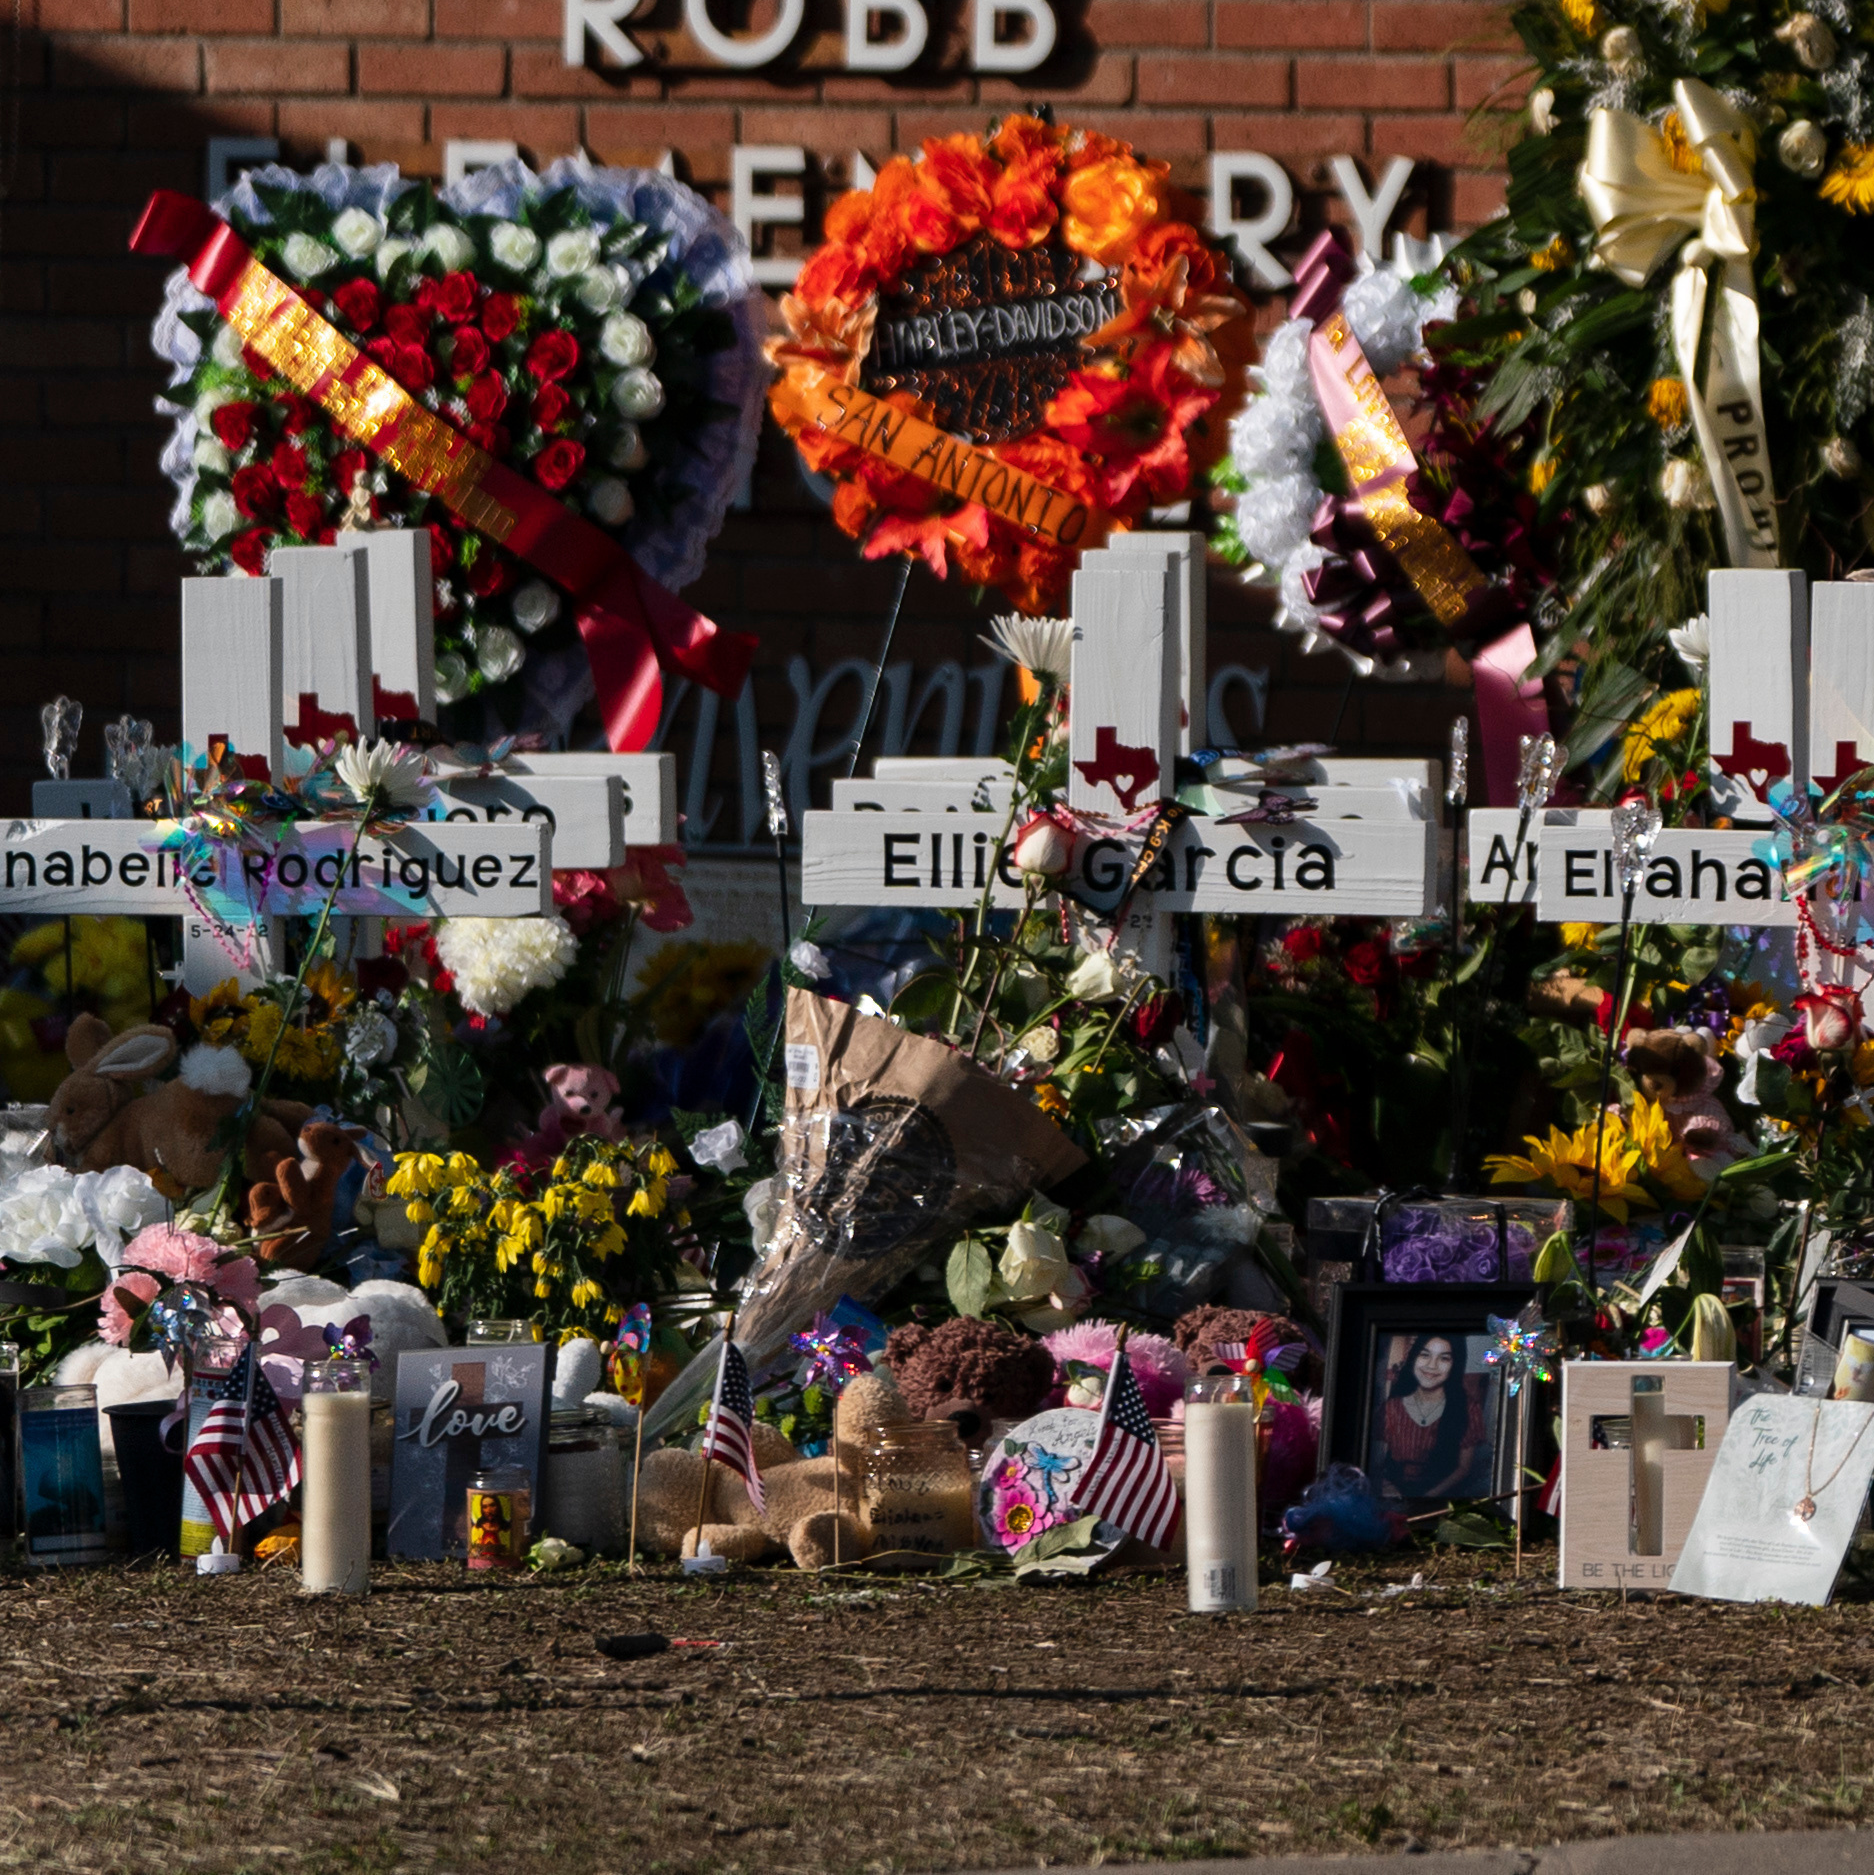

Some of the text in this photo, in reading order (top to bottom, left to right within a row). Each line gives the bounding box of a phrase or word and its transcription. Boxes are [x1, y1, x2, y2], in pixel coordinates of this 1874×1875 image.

[816, 386, 908, 456] SAN
[906, 440, 1090, 546] ANTONIO
[243, 844, 539, 899] Rodriguez
[883, 832, 1333, 891] Ellie Garcia
[397, 1379, 527, 1449] love
[1748, 1448, 1778, 1475] Life
[1752, 1426, 1799, 1458] Tree of
[1582, 1562, 1604, 1578] BE
[1611, 1562, 1646, 1578] THE
